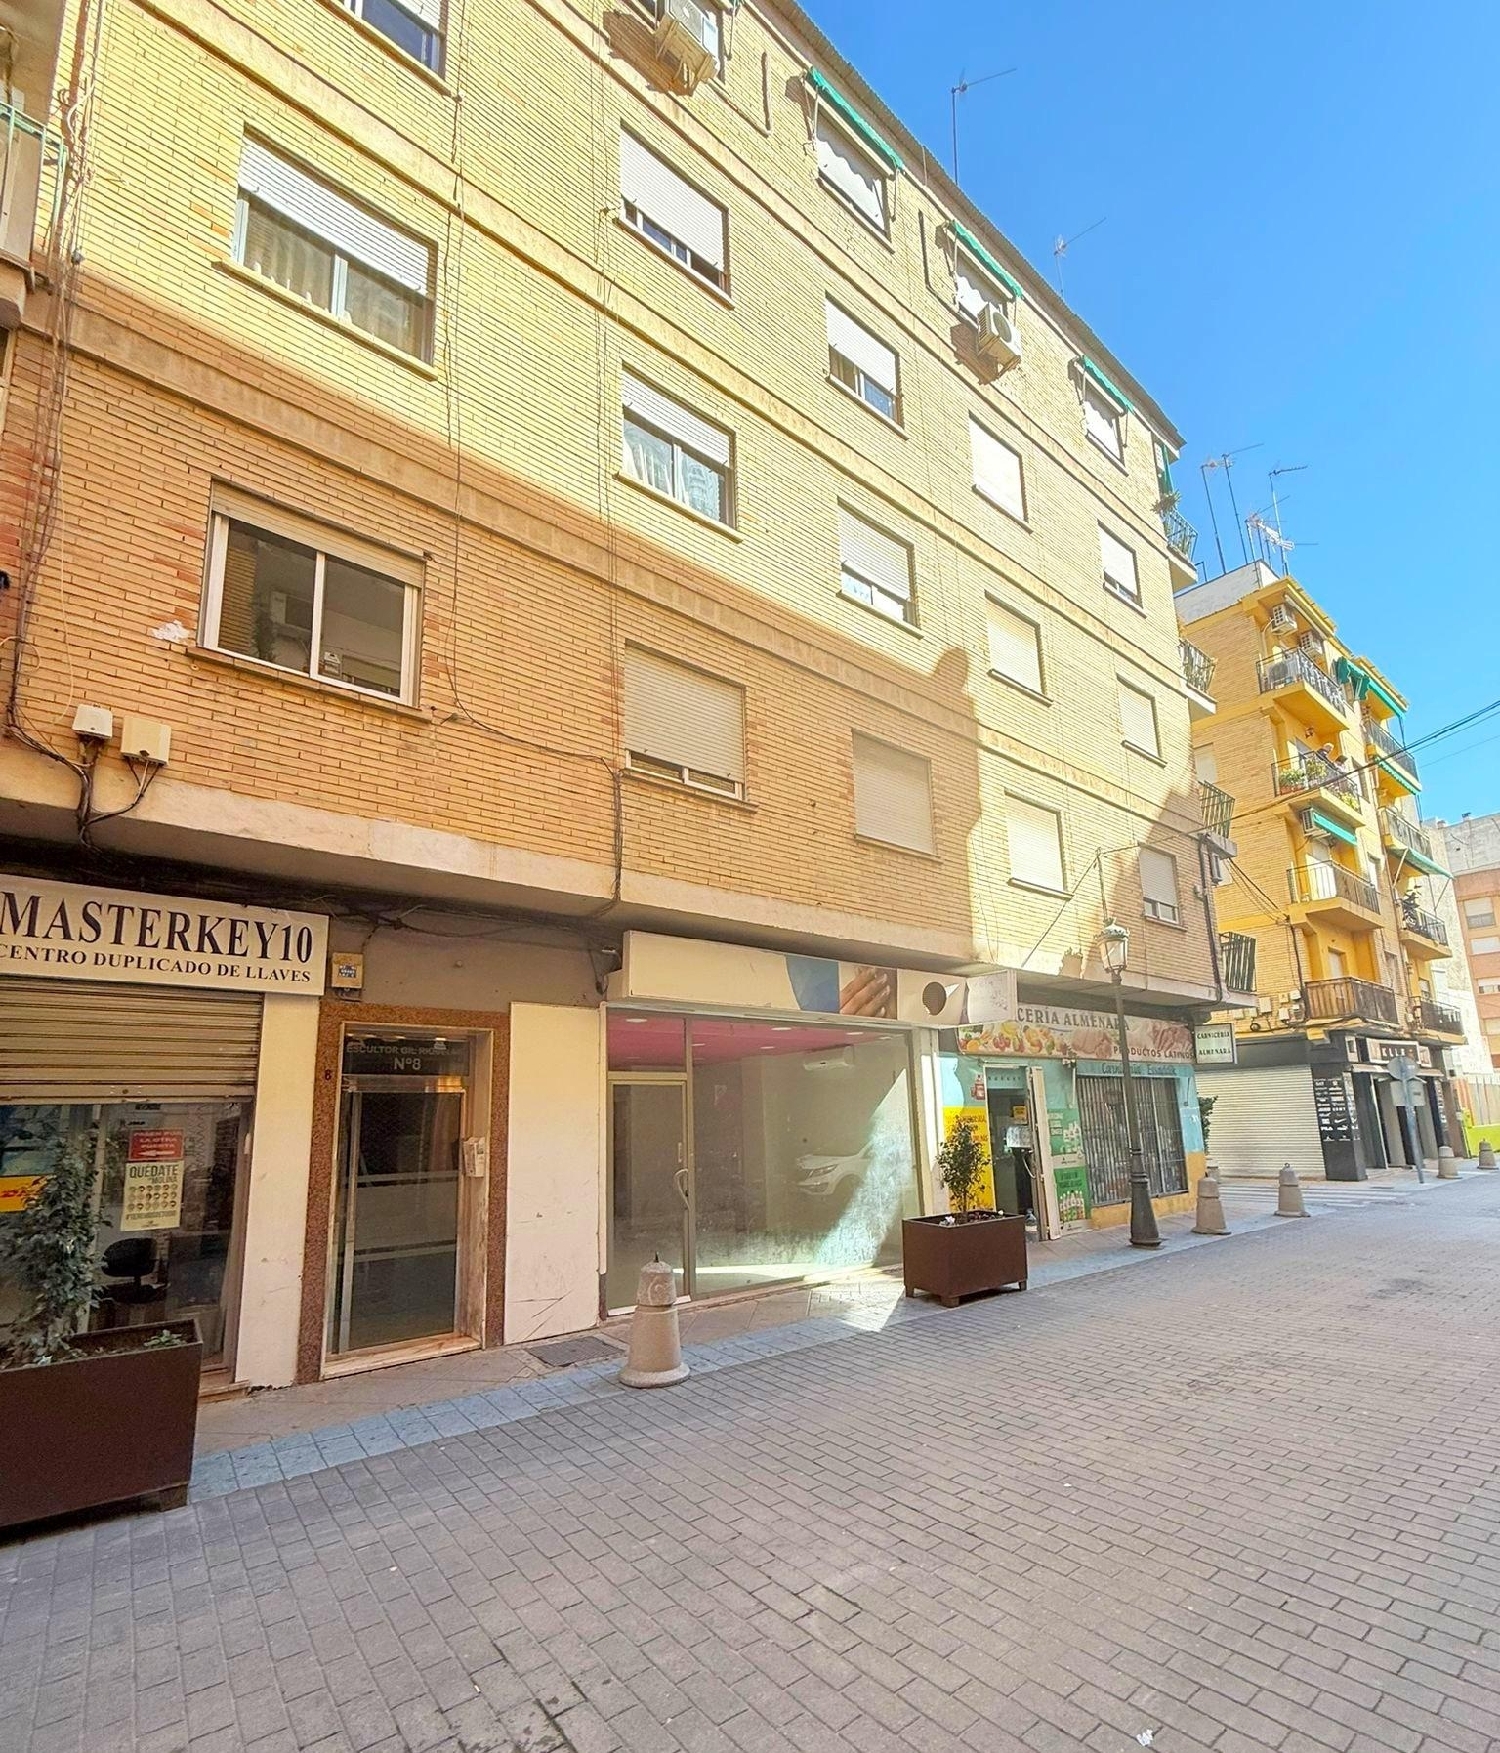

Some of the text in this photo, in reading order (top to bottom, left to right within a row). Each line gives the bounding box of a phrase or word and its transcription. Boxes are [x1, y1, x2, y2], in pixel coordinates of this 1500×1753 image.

[0, 891, 313, 964] MASTERKEY10
[0, 943, 311, 983] CENTRO DUPLICADO DE LLAVES
[1113, 1045, 1162, 1058] PDUCTOS
